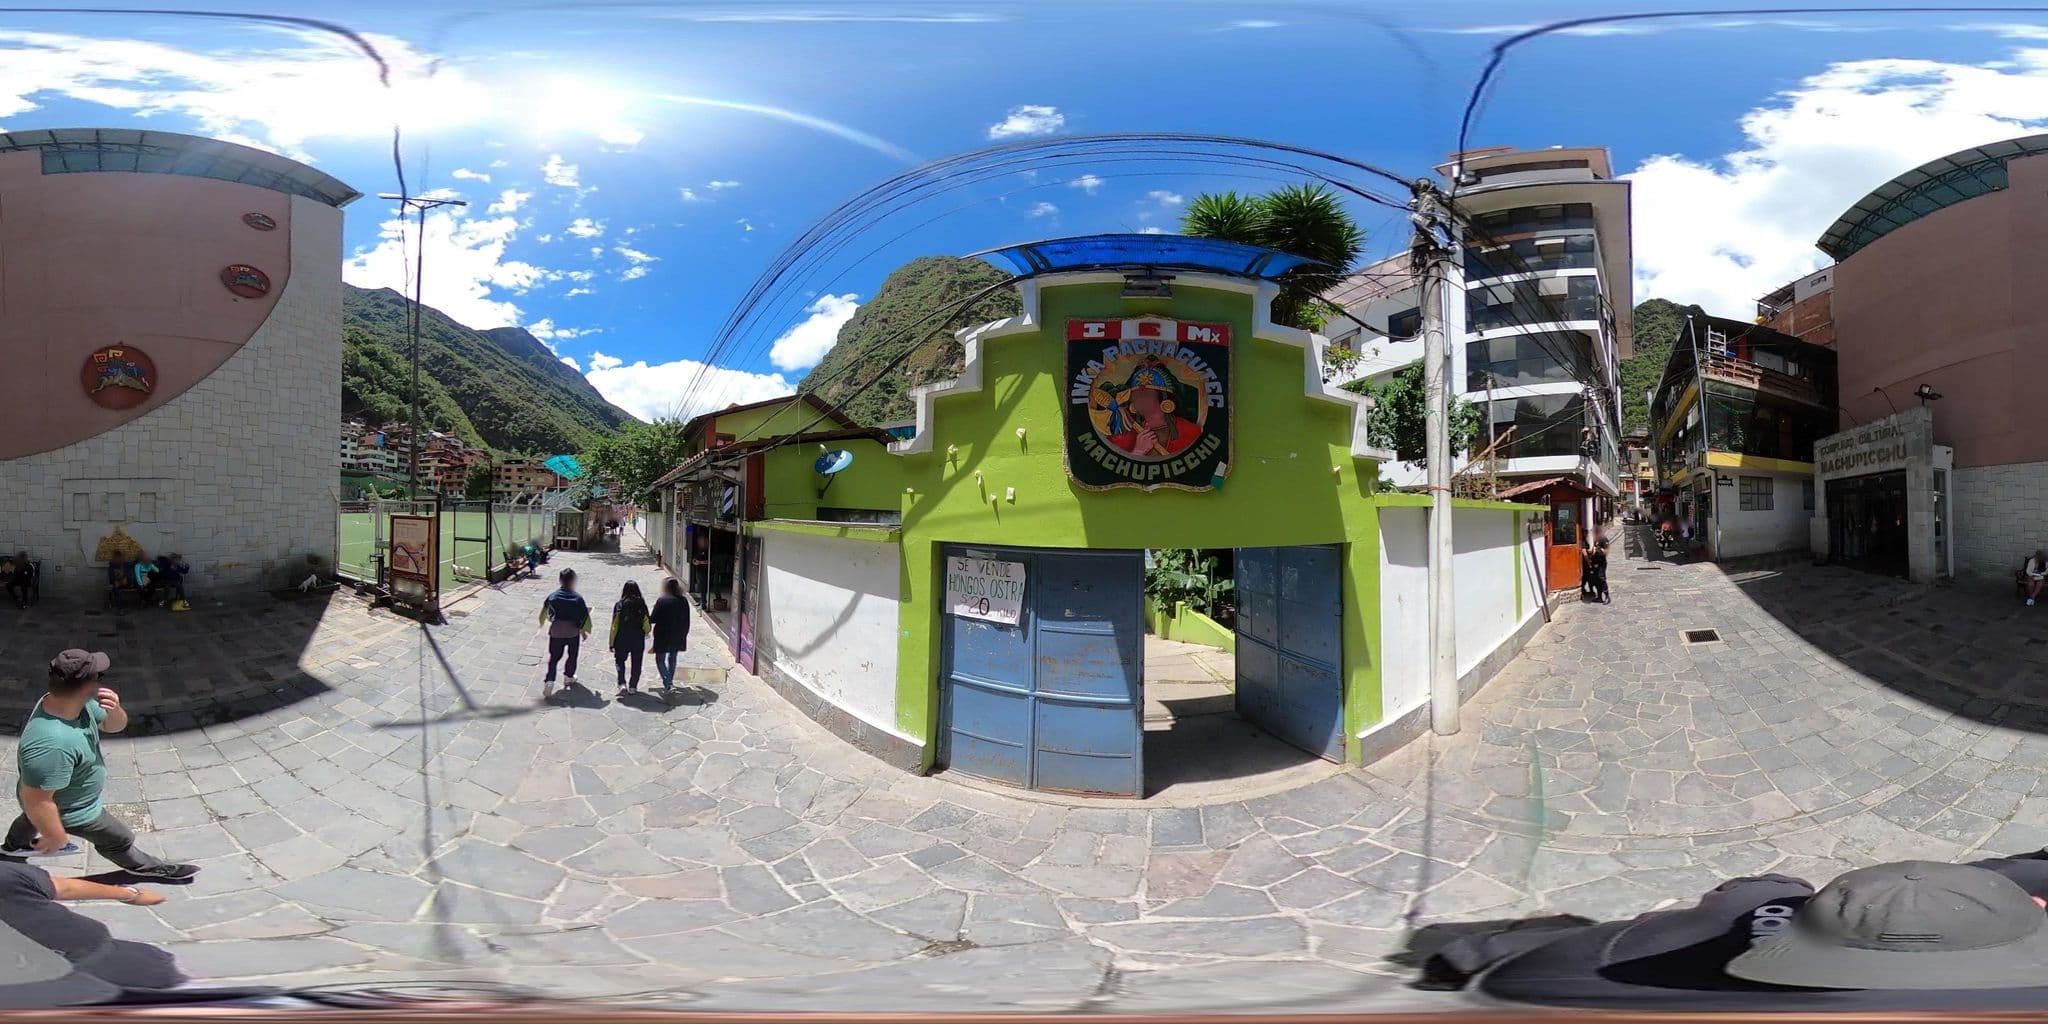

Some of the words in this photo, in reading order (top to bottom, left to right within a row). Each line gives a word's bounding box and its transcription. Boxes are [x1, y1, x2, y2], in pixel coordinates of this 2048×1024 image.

[1072, 359, 1105, 405] INKA
[1103, 339, 1225, 409] PACHACUTEC
[1077, 432, 1221, 480] MACHUPICCHU
[1820, 443, 1907, 473] MACHUPICCHU
[957, 559, 969, 571] SE
[977, 560, 1011, 577] VENDE
[948, 573, 985, 596] HONGOS
